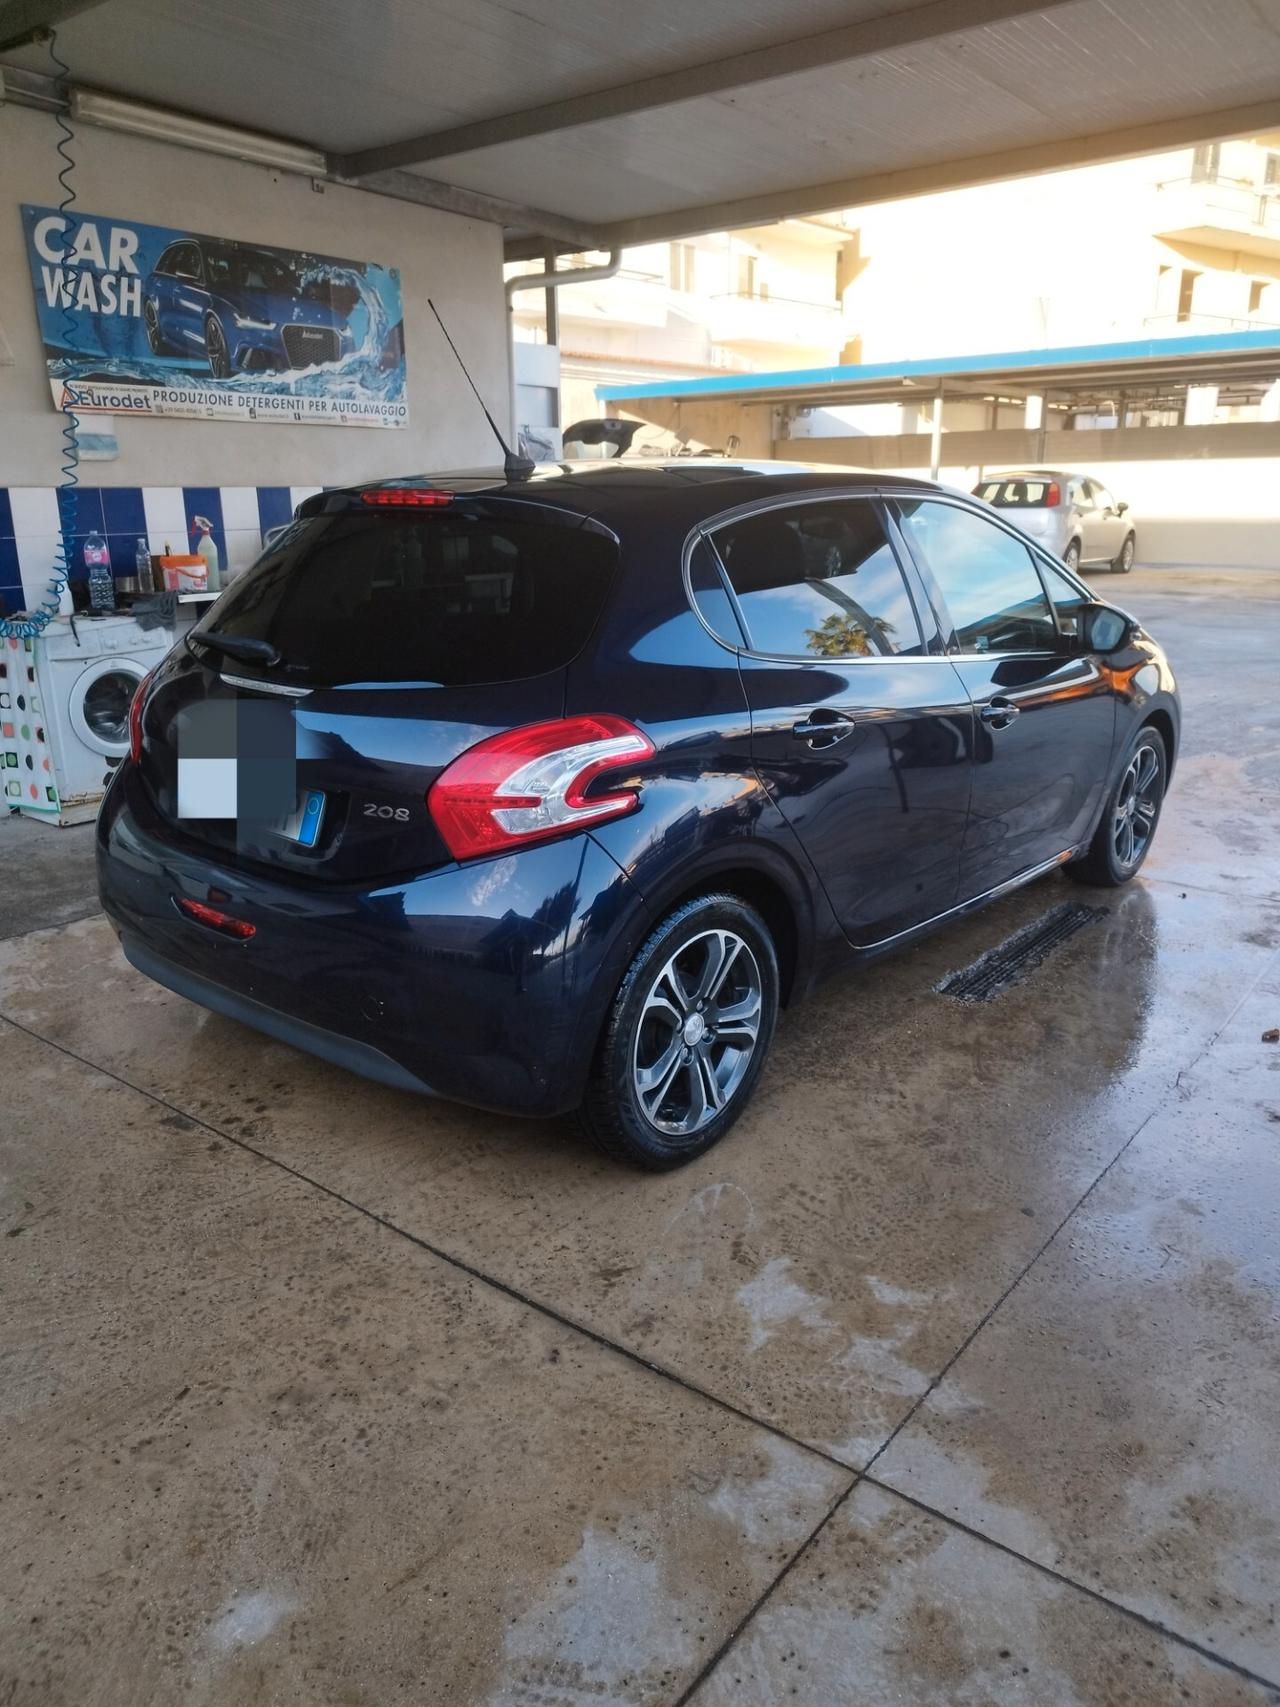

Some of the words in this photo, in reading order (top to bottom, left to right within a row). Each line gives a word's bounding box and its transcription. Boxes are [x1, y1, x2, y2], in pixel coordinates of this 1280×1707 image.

[34, 216, 139, 274] CAR
[41, 265, 142, 317] WASH
[78, 389, 151, 409] Eurodet
[153, 390, 233, 406] PRODUZIONE
[238, 396, 304, 410] DETERGENTI
[309, 400, 327, 412] PER
[331, 402, 406, 416] AUTOLAVAGGIO
[363, 803, 410, 821] 208
